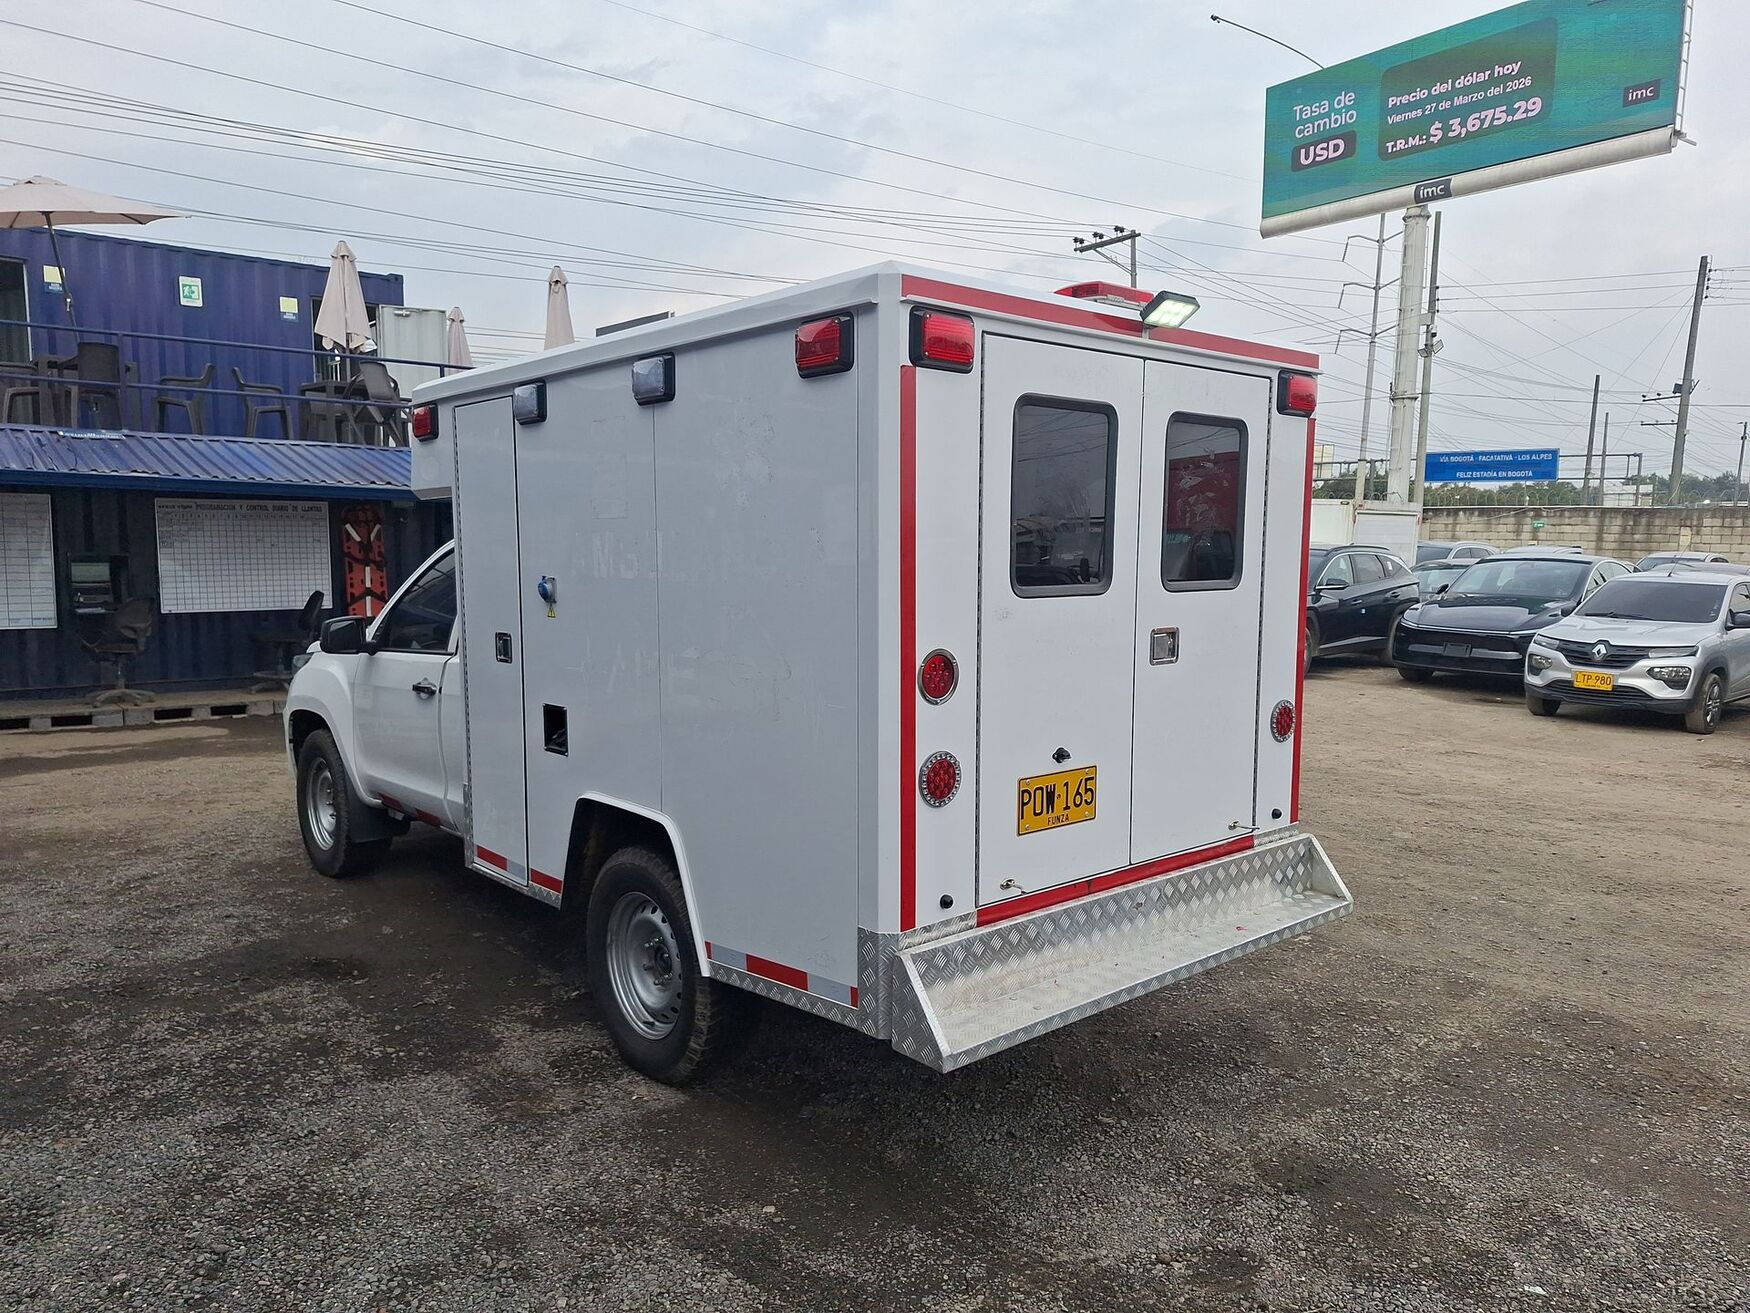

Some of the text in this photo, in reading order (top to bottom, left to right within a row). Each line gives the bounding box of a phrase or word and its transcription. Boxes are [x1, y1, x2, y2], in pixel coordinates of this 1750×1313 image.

[1388, 60, 1522, 108] Precio del dólar hoy
[1628, 86, 1655, 101] imc
[1293, 91, 1356, 121] Tasa de
[1387, 76, 1532, 125] Viernes 27 de Marzo del 2026
[1295, 109, 1357, 138] cambio
[1385, 96, 1543, 153] T.R.M.: $ 3,675.29
[1300, 138, 1345, 165] USD
[1420, 185, 1445, 199] imc
[1450, 454, 1474, 462] BOGOTÁ
[1473, 469, 1497, 478] ESTADÍA
[1047, 814, 1070, 826] FUNZA
